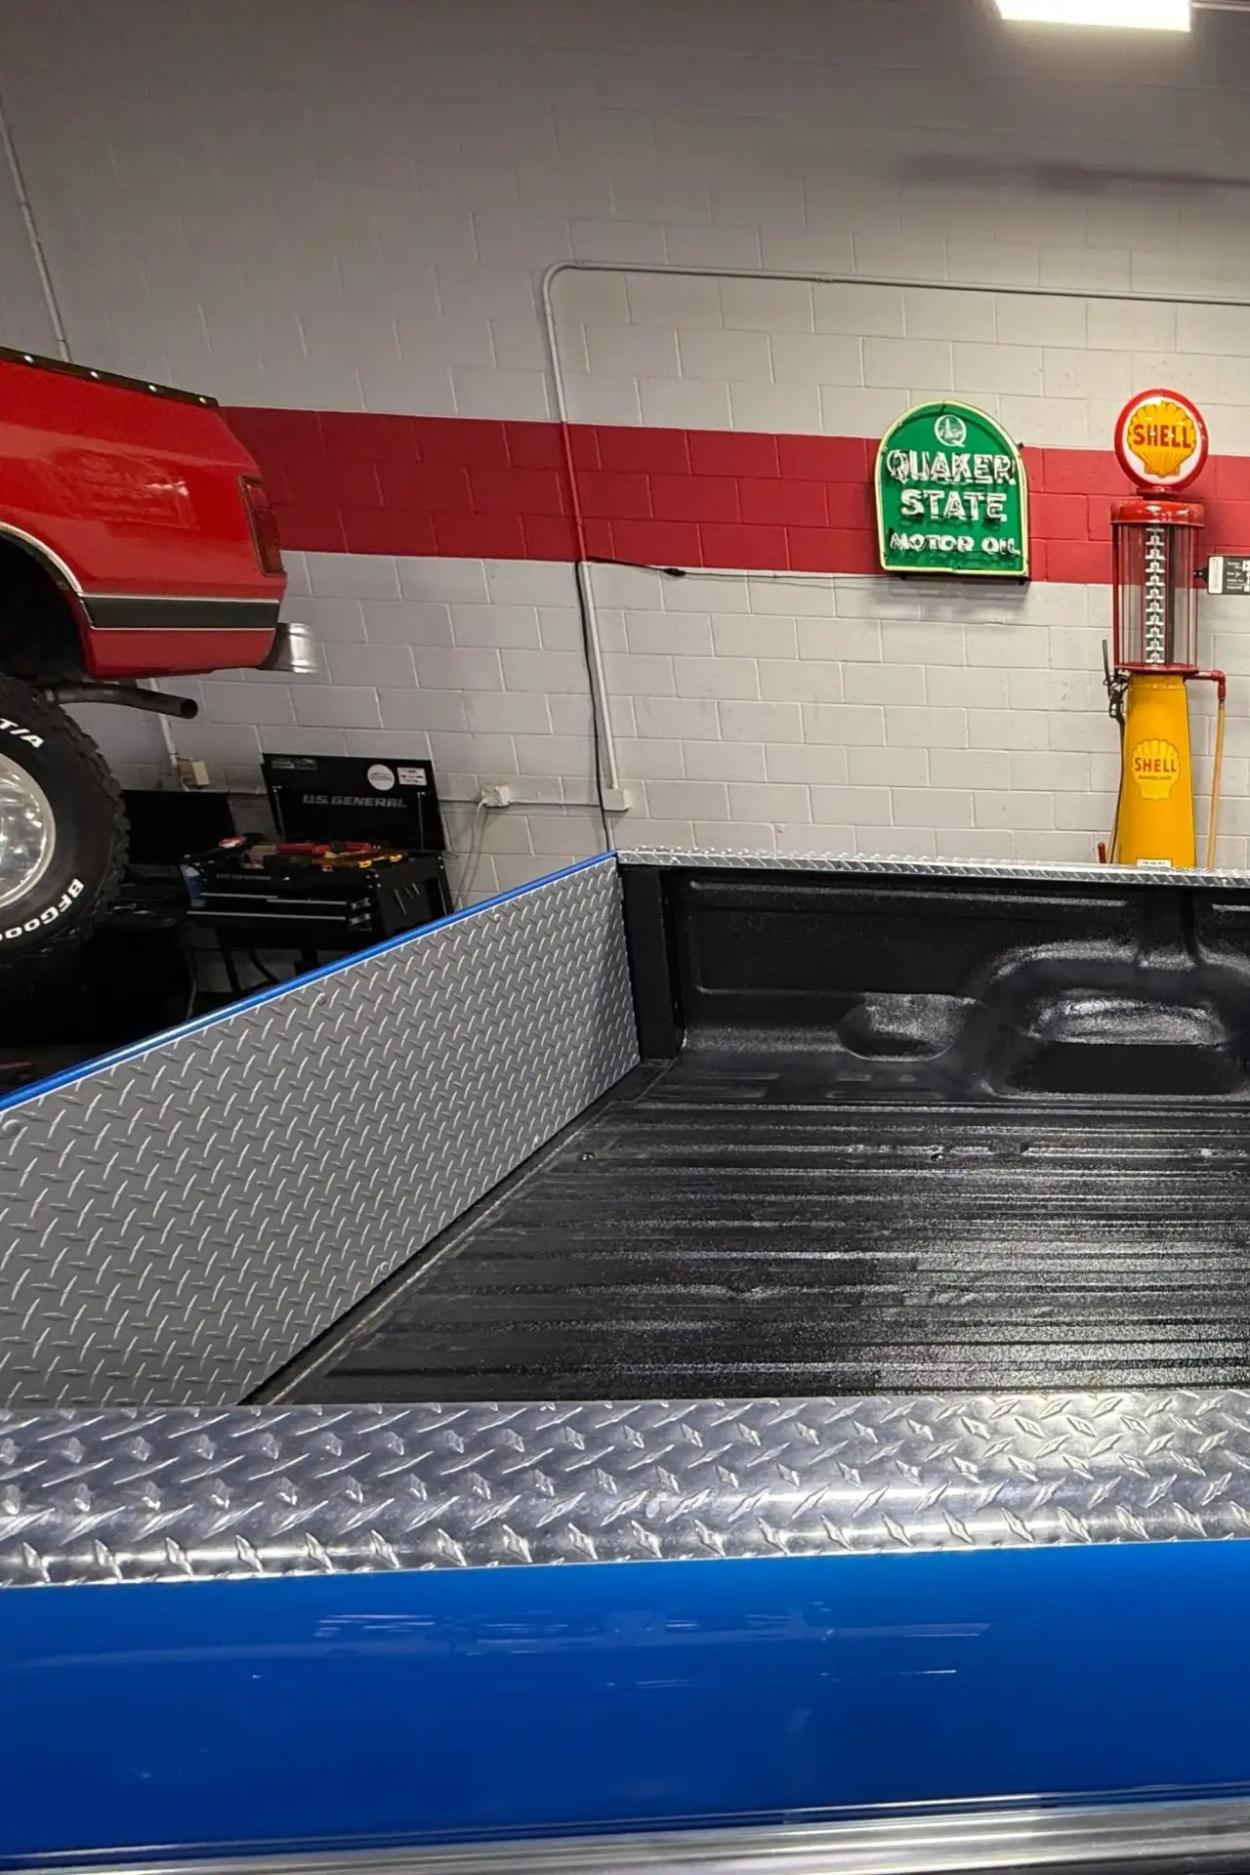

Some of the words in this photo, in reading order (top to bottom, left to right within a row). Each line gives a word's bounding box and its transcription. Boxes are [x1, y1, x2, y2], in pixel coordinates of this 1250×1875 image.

[1132, 423, 1192, 449] SHELL
[886, 450, 1017, 485] QUAKER
[901, 488, 1008, 522] STATE
[889, 532, 976, 553] MOTOR
[981, 536, 1021, 555] OIL
[1134, 757, 1178, 773] SHELL
[331, 795, 408, 808] GENERAL
